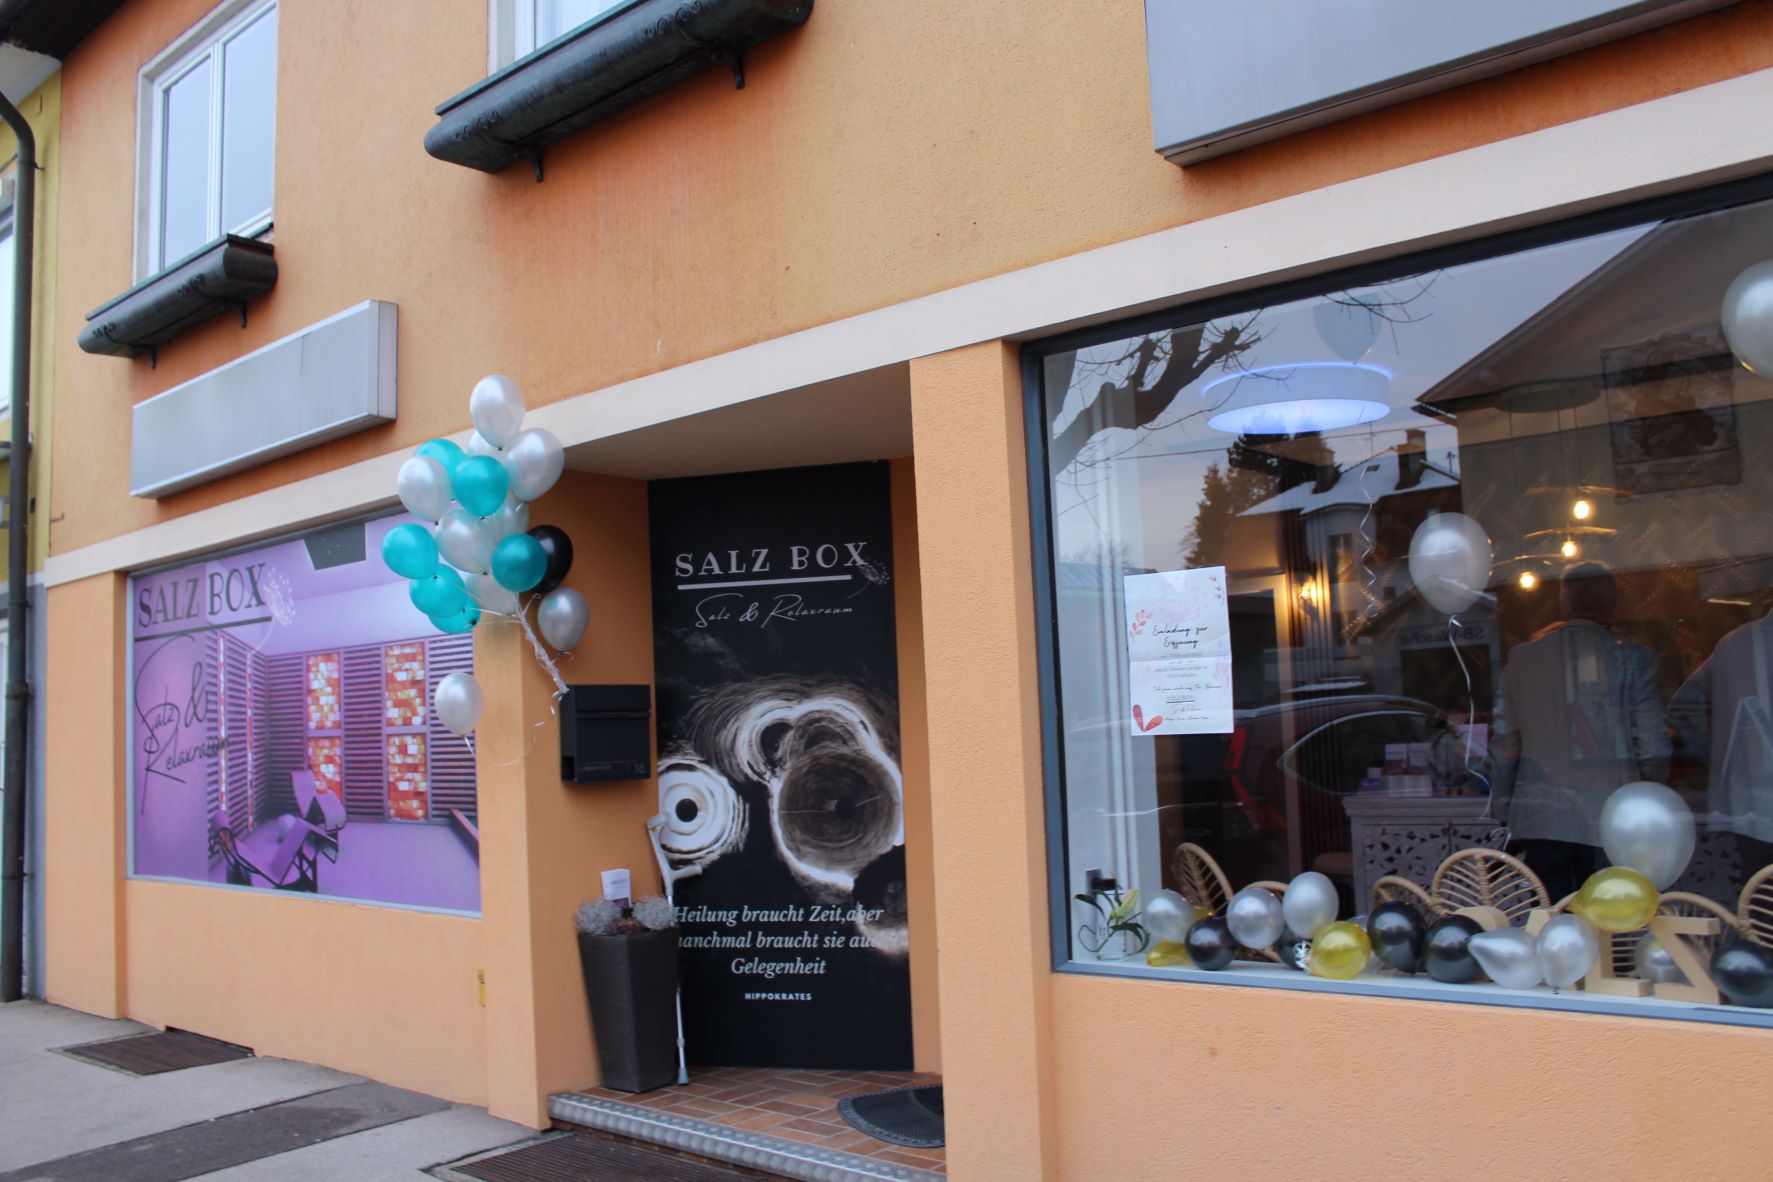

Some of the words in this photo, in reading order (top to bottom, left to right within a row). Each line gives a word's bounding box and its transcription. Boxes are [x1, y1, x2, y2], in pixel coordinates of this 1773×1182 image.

[675, 548, 770, 577] SALZ
[789, 542, 868, 570] BOX
[138, 577, 199, 628] SALZ
[208, 563, 267, 616] BOX
[739, 602, 759, 621] &
[674, 905, 739, 927] Heilung
[742, 905, 805, 922] braucht
[678, 931, 753, 948] anchmal
[756, 931, 819, 948] braucht
[823, 931, 846, 948] sie
[731, 957, 827, 979] Gelegenheit
[744, 992, 812, 1001] HIPPOKRATES
